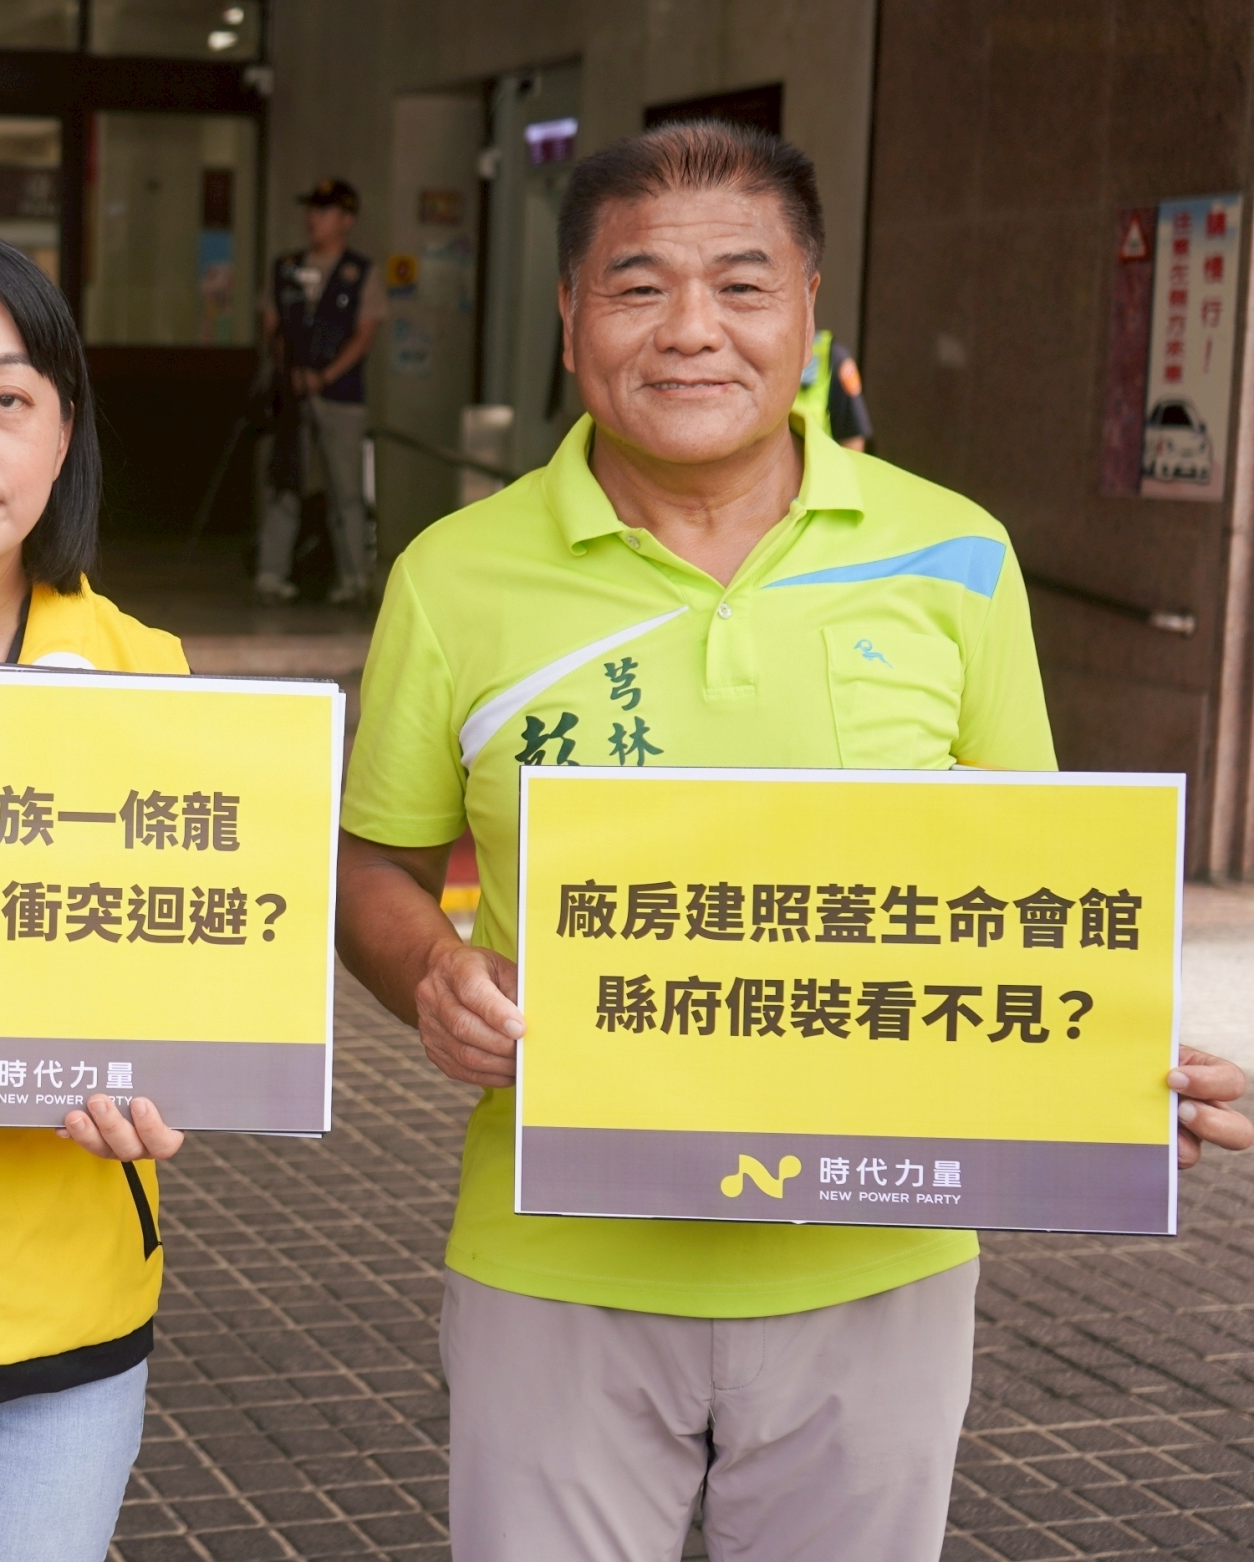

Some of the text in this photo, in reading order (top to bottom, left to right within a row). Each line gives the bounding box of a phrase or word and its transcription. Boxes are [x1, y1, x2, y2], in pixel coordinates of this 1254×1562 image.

[604, 656, 664, 766] 芎林
[556, 878, 1143, 951] 廠房建照蓋生命會館
[35, 1094, 84, 1106] POWER
[819, 1156, 962, 1188] 時代力量
[819, 1190, 961, 1205] NEW POWER PARTY
